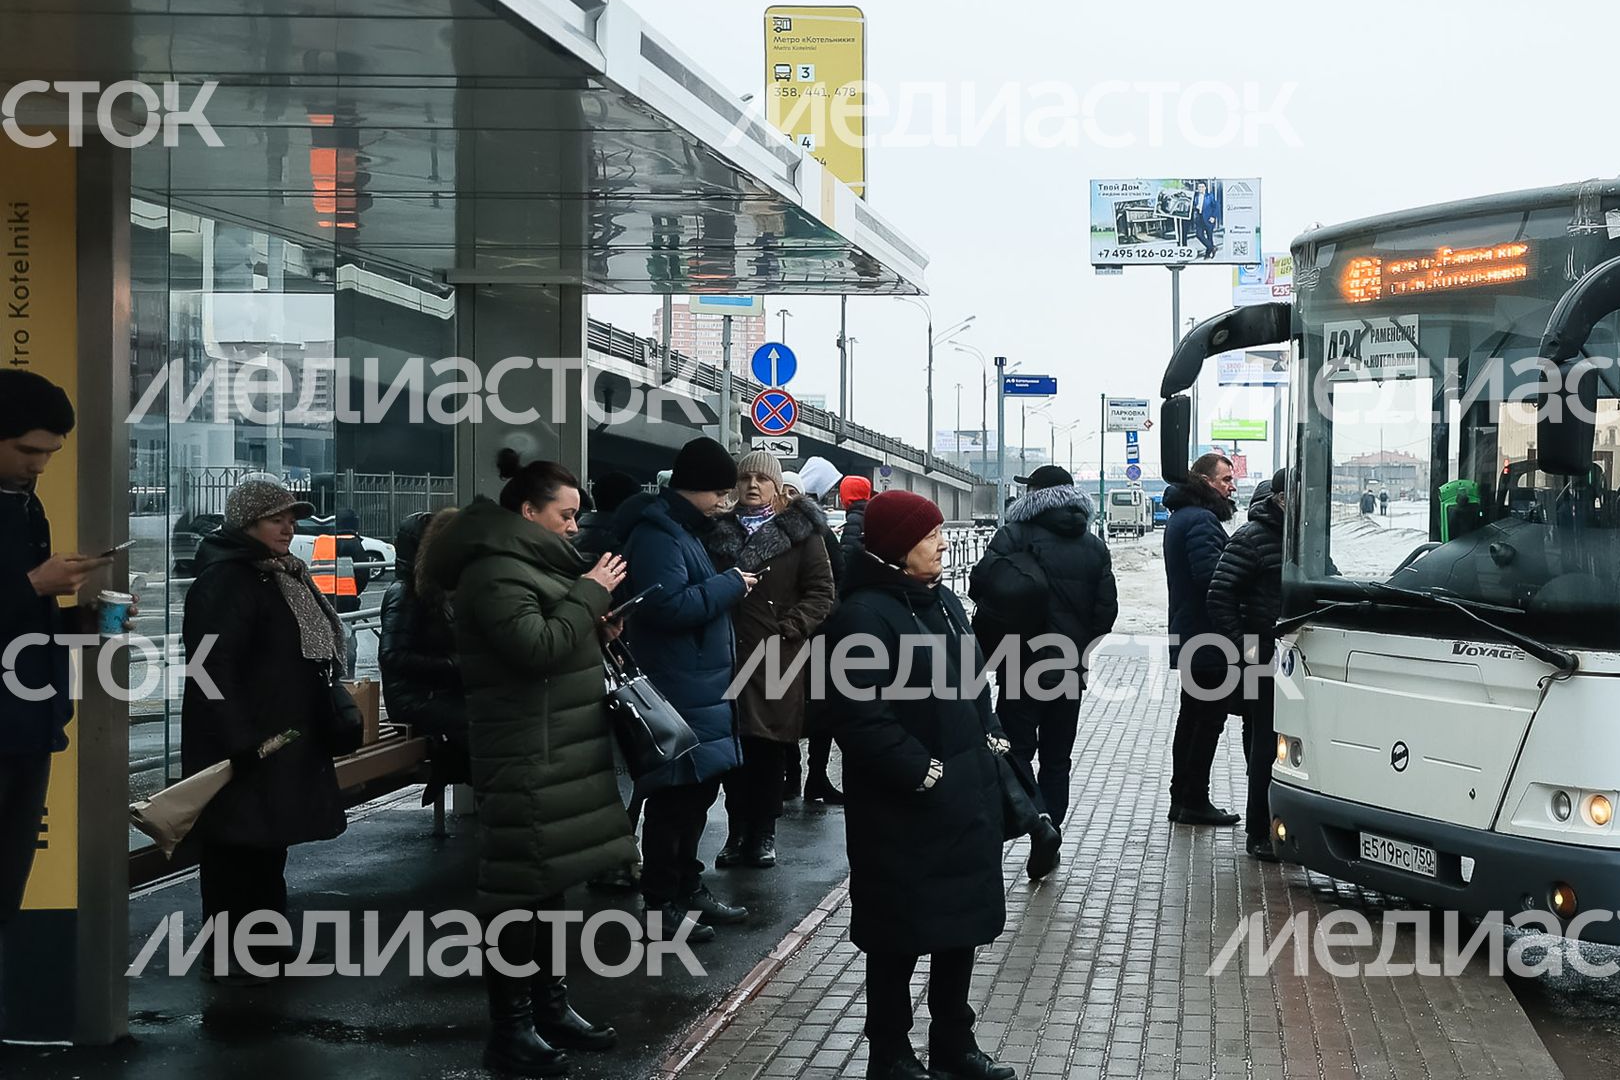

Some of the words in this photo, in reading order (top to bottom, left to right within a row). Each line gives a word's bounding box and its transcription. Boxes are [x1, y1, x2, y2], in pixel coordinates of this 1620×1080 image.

[801, 66, 810, 78] 3
[834, 87, 856, 97] 478
[802, 136, 811, 148] 4
[1121, 183, 1139, 191] Дом
[1098, 249, 1110, 258] +7
[1112, 249, 1133, 258] 495
[1136, 249, 1193, 258] 126-02-52
[8, 202, 30, 318] Kotelniki
[1370, 325, 1416, 344] РАМЕНСКОЕ
[9, 329, 30, 370] tro
[1413, 847, 1432, 867] 750
